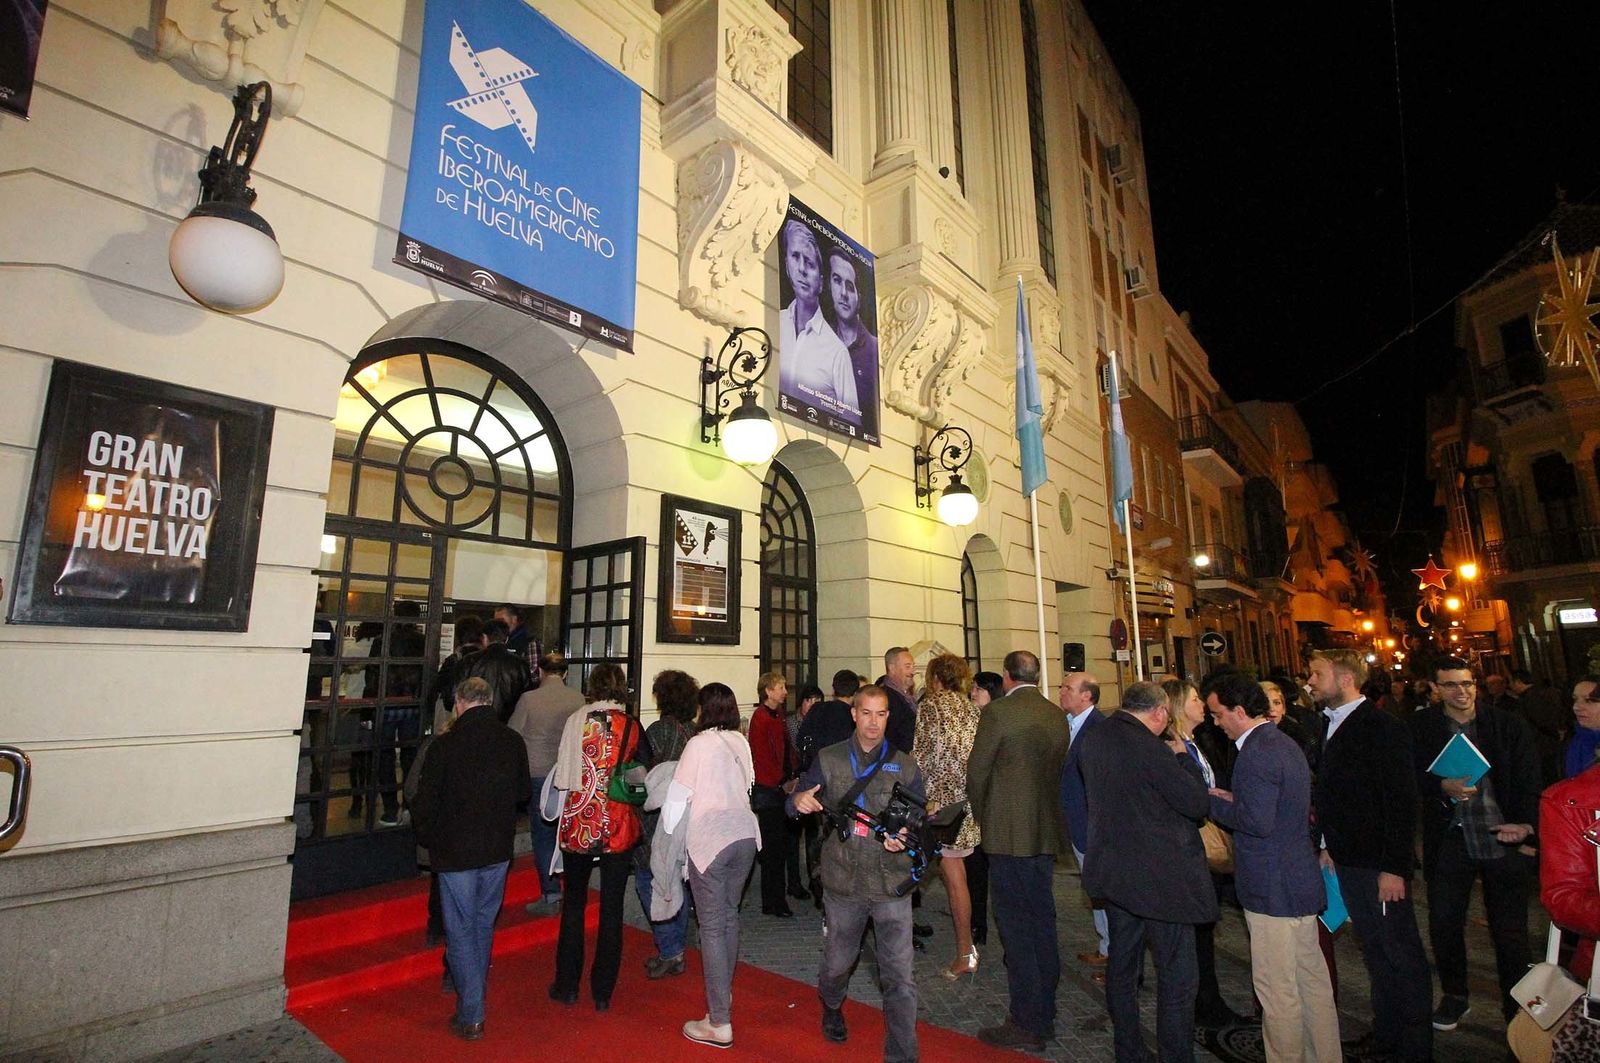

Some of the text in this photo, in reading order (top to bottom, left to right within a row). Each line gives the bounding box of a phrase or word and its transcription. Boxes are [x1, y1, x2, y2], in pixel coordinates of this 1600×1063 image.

[438, 149, 615, 258] IBEROAMERICANO
[441, 124, 600, 228] FESTIVAL DE CINE
[436, 187, 544, 252] DE HUELVA
[87, 431, 183, 479] GRAN
[83, 470, 212, 520] TEATRO
[74, 511, 207, 560] HUELVA
